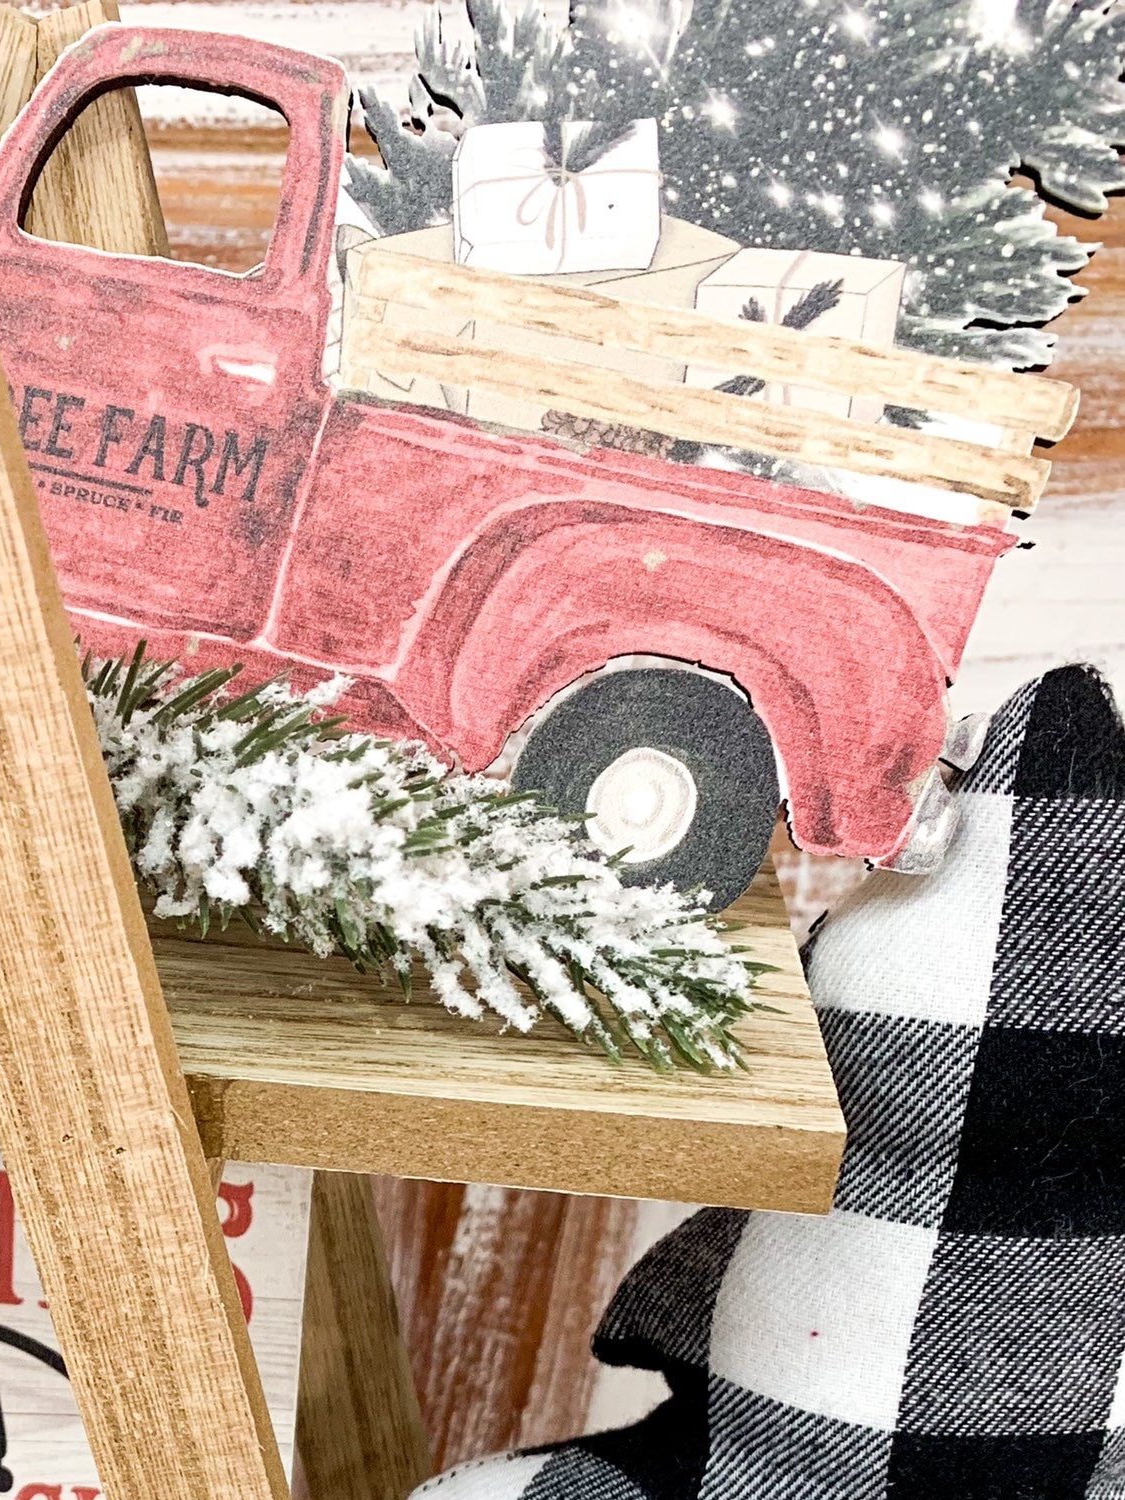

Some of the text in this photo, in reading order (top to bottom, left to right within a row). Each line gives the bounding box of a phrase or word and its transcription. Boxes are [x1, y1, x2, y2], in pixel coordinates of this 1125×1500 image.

[8, 384, 270, 509] EE FARM
[48, 480, 186, 525] SPRUCE FIR
